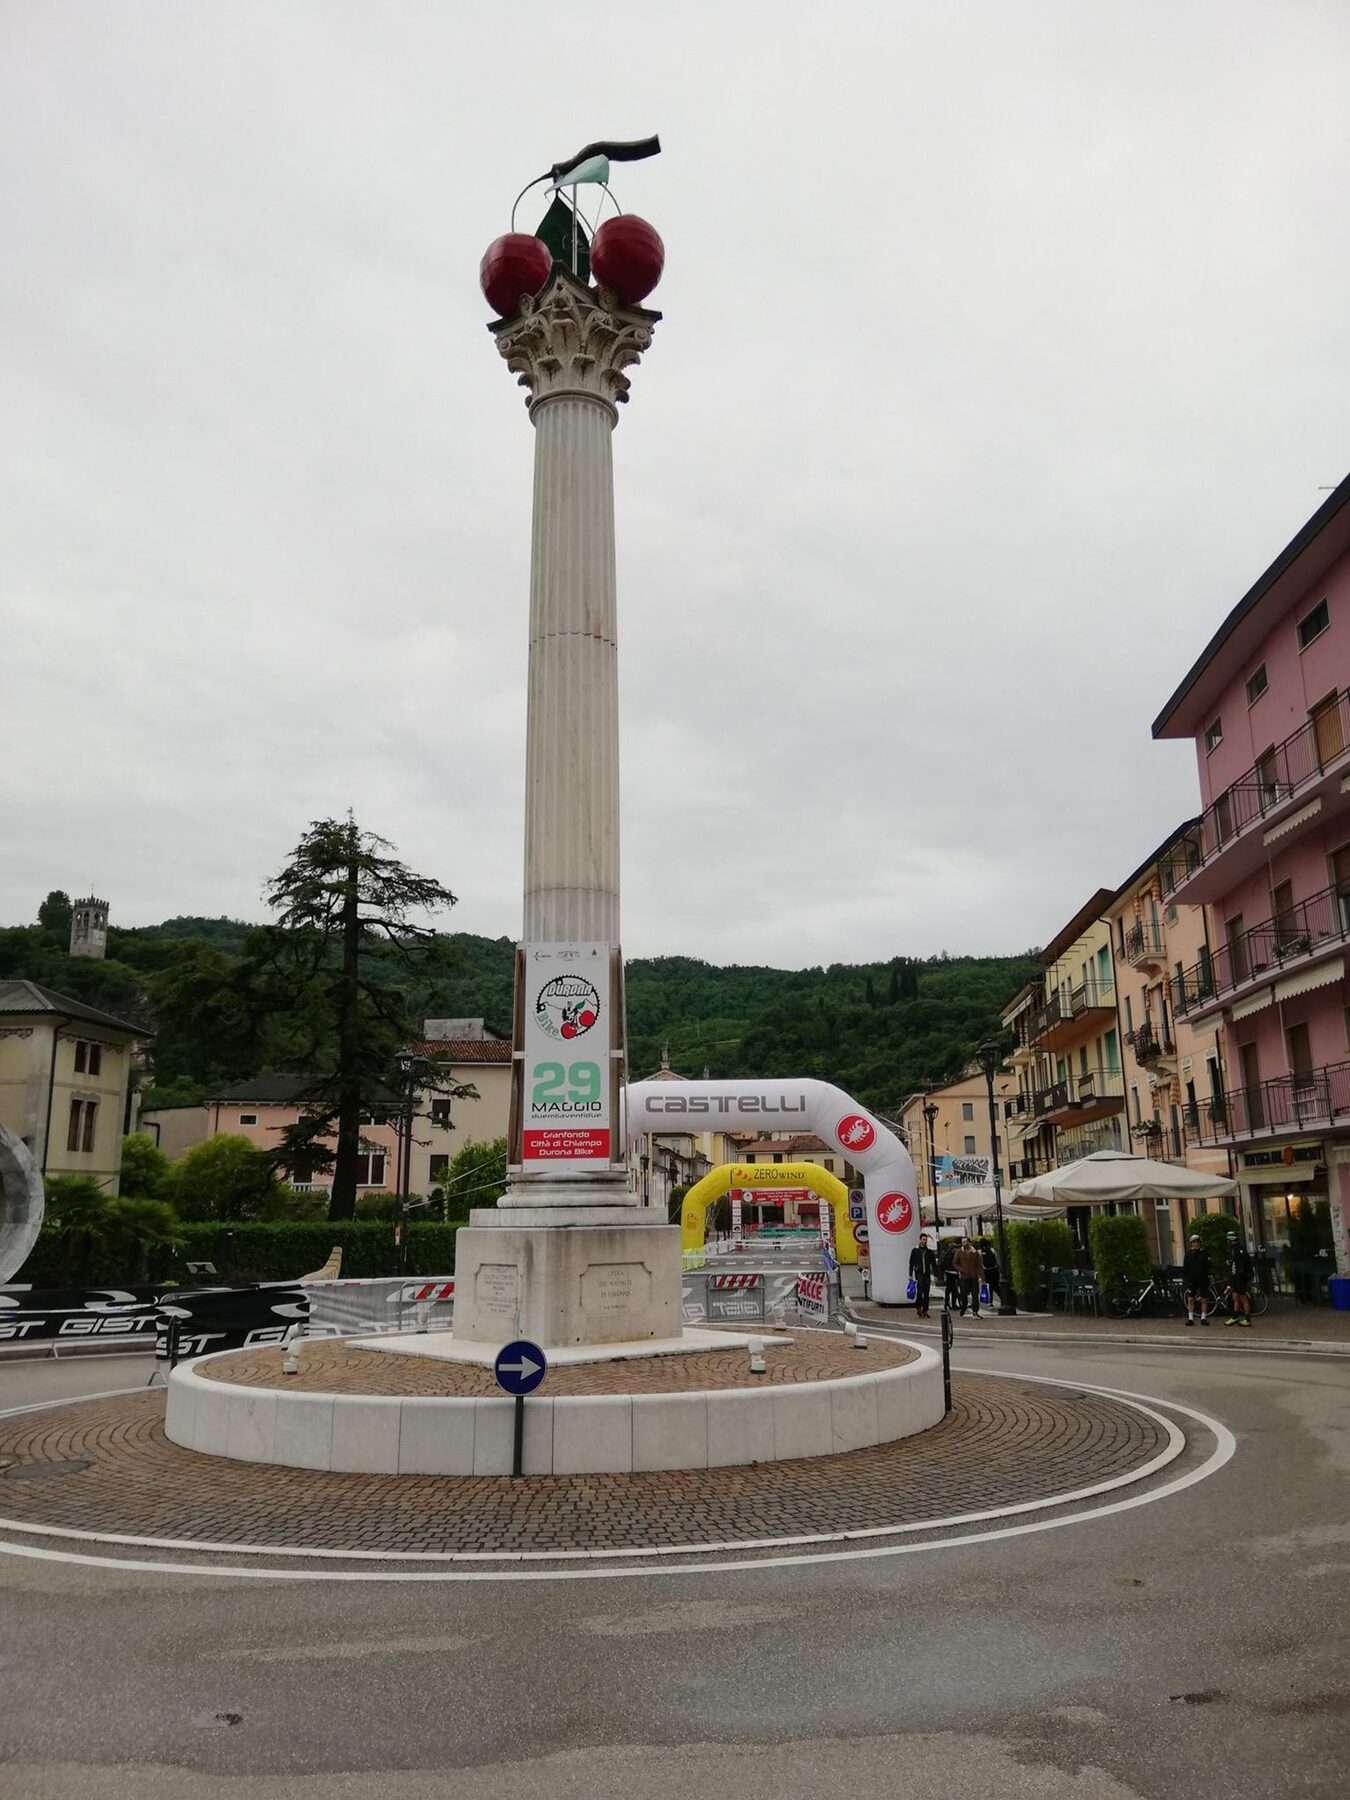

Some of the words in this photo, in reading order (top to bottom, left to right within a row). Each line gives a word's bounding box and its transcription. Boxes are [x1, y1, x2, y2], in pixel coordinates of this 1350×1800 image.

[547, 984, 593, 997] DURONA
[538, 1013, 559, 1036] Bike
[532, 1061, 601, 1103] 29
[532, 1101, 602, 1112] MAGGIO
[543, 1131, 590, 1139] Granfondo
[563, 1140, 602, 1148] Chiampo
[797, 1297, 825, 1314] NTIFURTI
[59, 1315, 157, 1334] GIST
